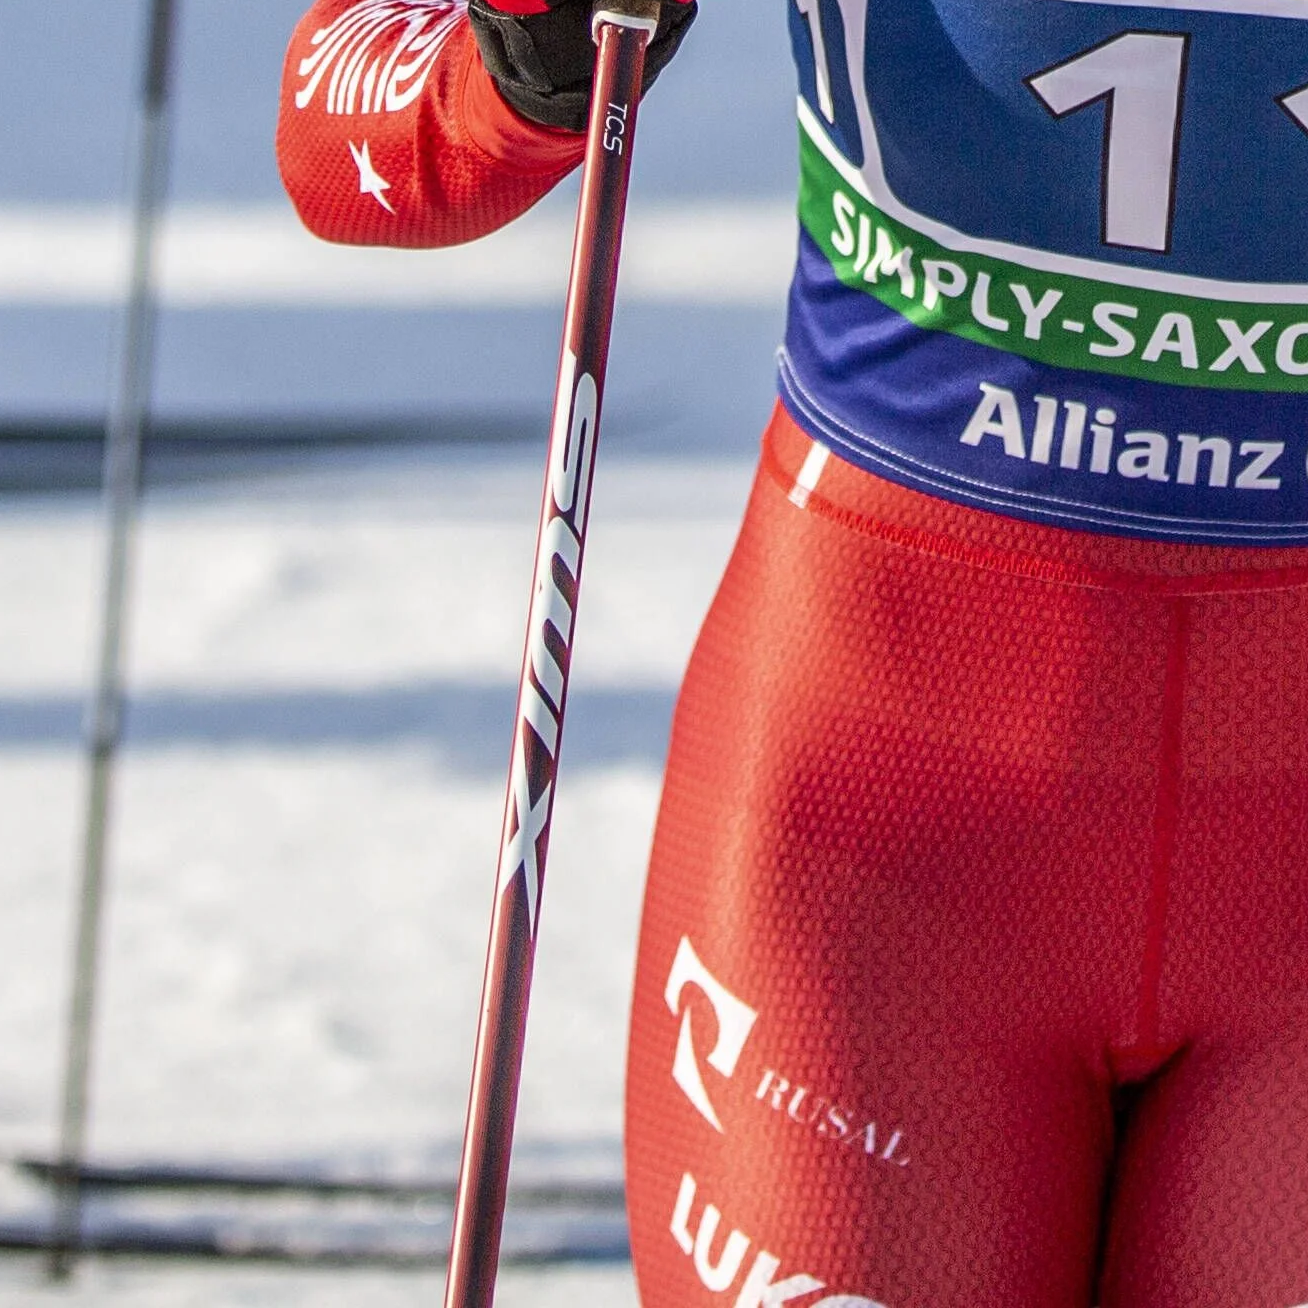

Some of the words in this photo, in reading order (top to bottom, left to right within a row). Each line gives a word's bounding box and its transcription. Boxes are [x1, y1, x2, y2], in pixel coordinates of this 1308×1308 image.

[959, 382, 1285, 492] Allianz
[755, 1068, 911, 1167] RUSAL
[670, 1171, 892, 1308] LUK
